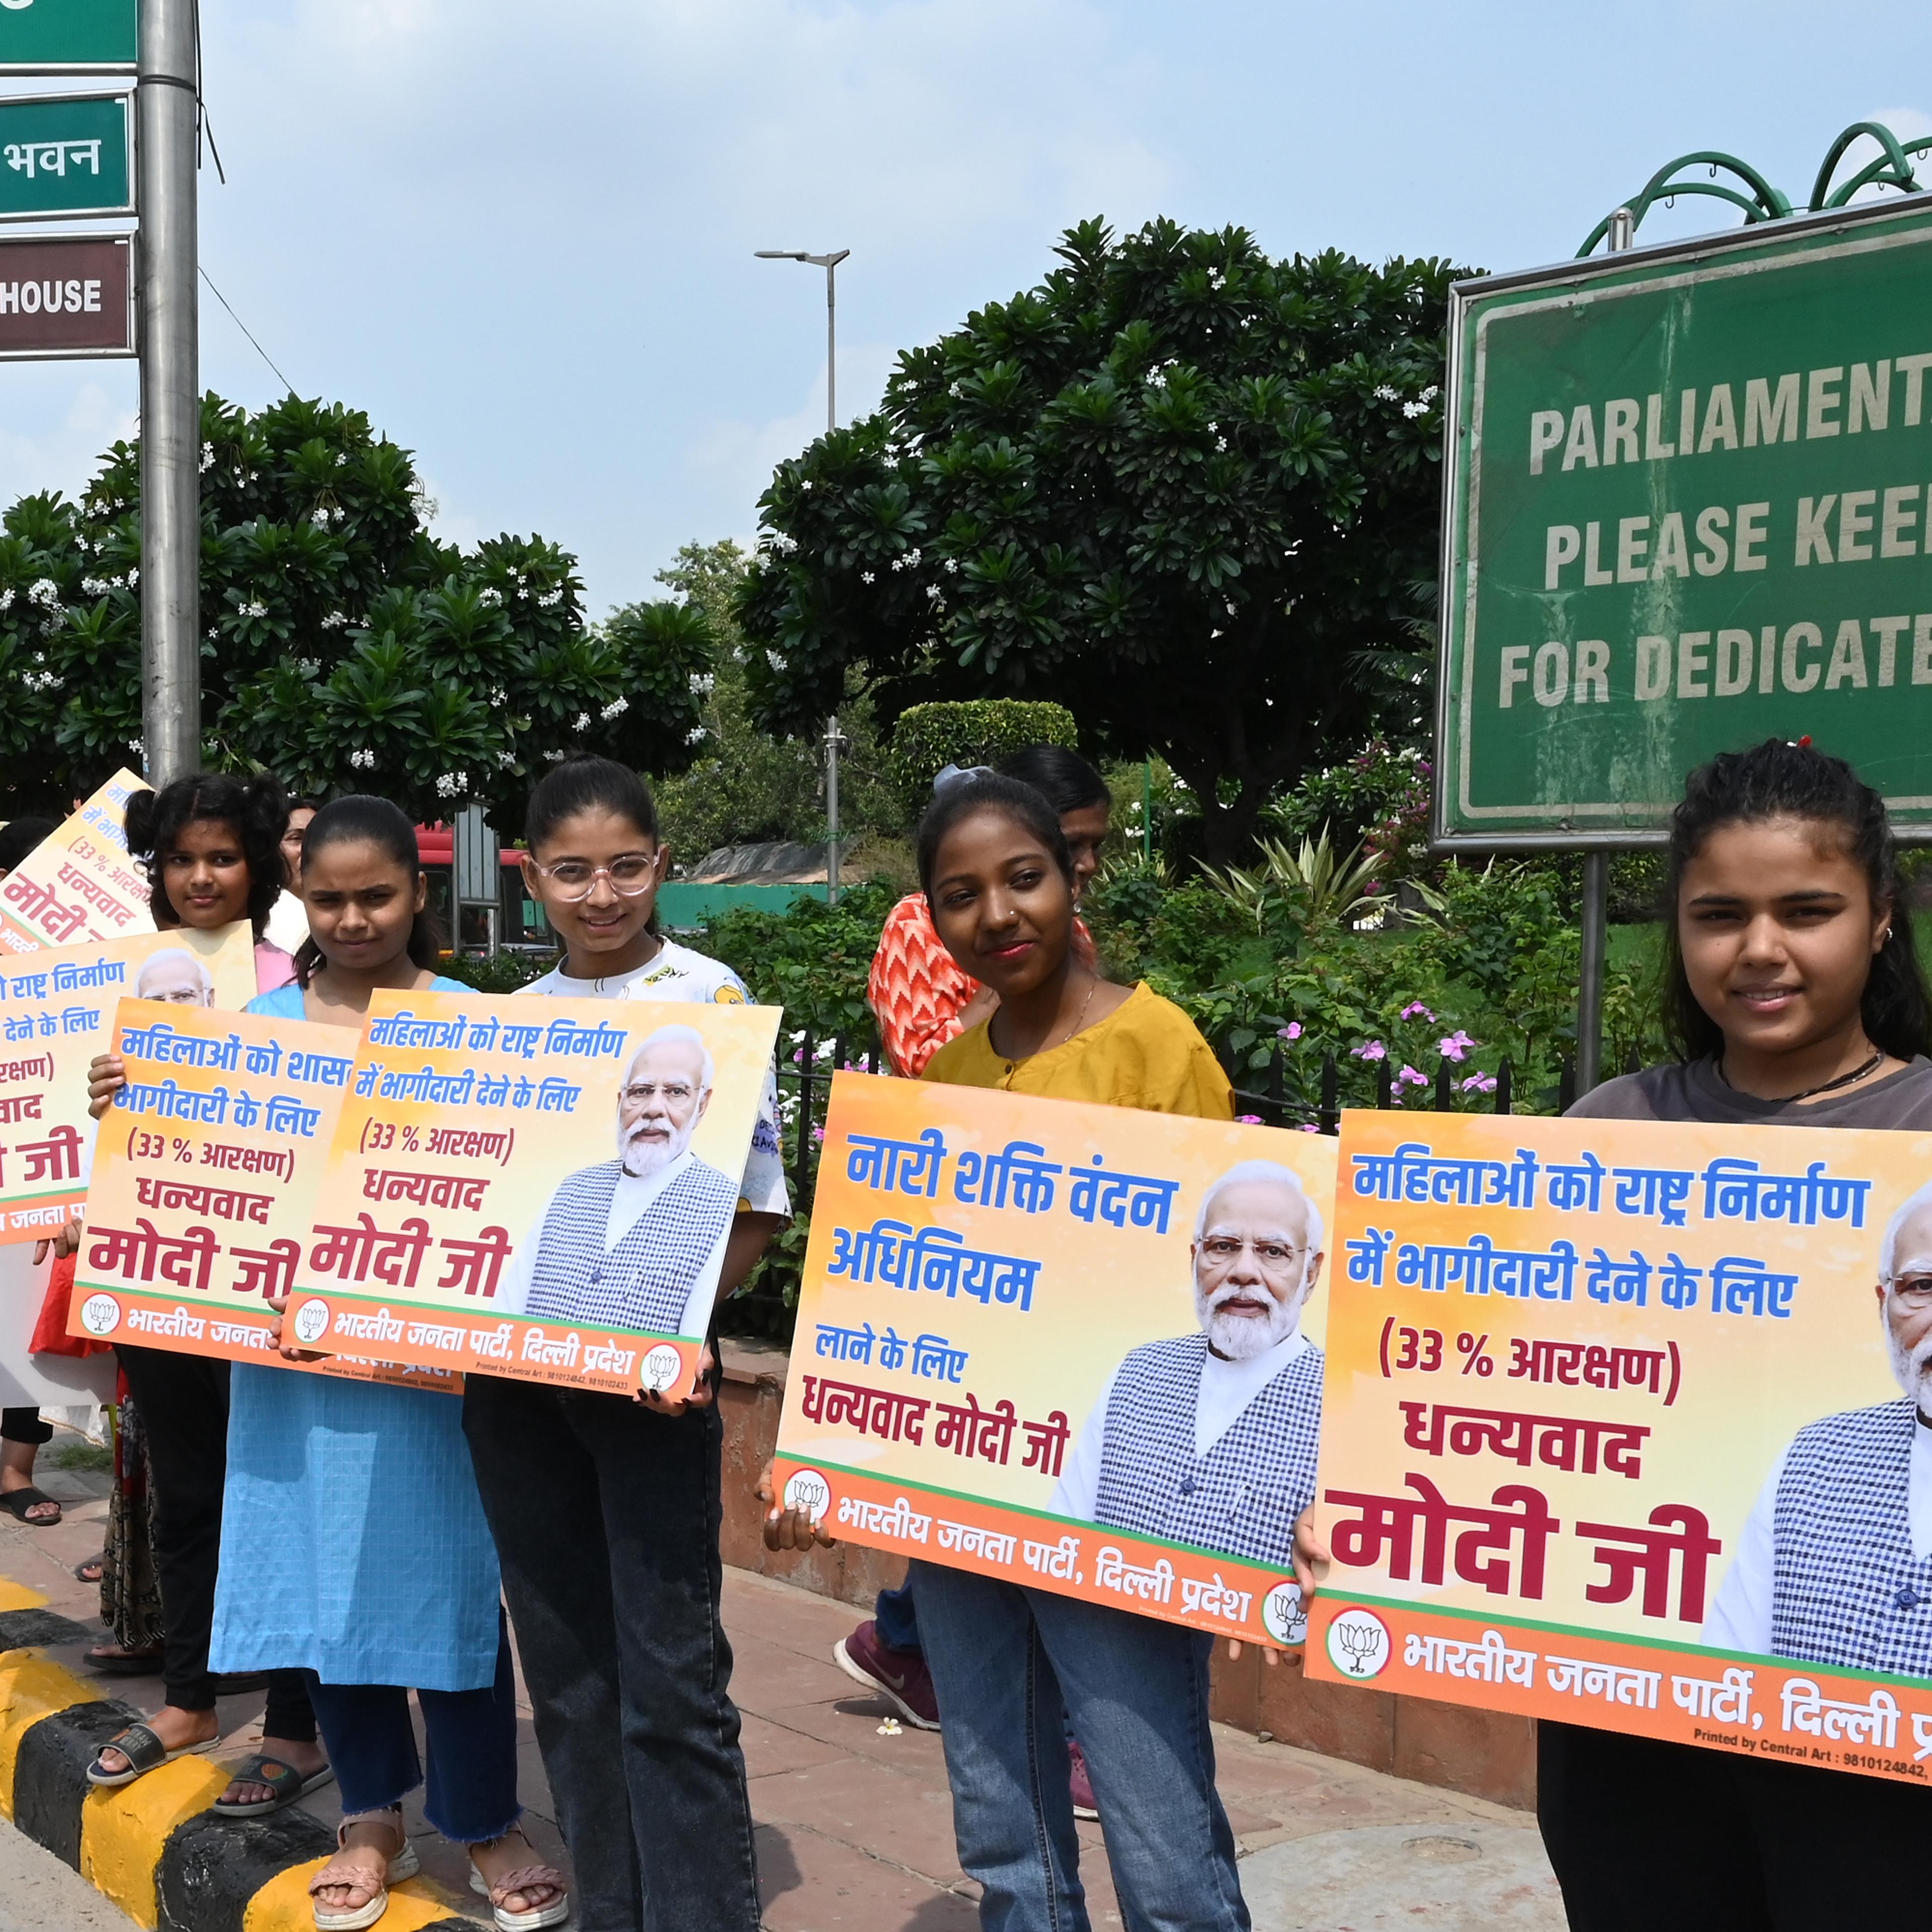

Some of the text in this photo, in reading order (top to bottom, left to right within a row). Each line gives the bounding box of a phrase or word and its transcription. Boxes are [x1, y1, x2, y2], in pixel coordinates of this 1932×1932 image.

[4, 139, 101, 178] भवन
[0, 280, 101, 314] HOUSE
[1530, 352, 1932, 475] PARLIAMENT
[1545, 484, 1932, 590] PLEASE KEE
[1499, 639, 1611, 708] FOR
[68, 836, 96, 859] (33
[94, 855, 110, 871] %
[4, 872, 87, 942] मोदी
[57, 862, 136, 927] धन्यवाद
[11, 973, 48, 999] राष्ट्र
[52, 957, 125, 992] निर्माण
[4, 1007, 100, 1041] देने के लिए
[122, 1023, 354, 1087] महिलाओं को शास
[369, 1012, 627, 1059] महिलाओं को राष्ट्र निर्माण
[114, 1080, 321, 1137] भागीदारी के लिए
[355, 1064, 582, 1112] में भागीदारी देने के लिए
[15, 1125, 84, 1181] जी
[127, 1127, 295, 1183] (33 % आरक्षण)
[360, 1117, 514, 1166] (33 % आरक्षण)
[136, 1177, 275, 1225] धन्यवाद
[363, 1169, 491, 1211] धन्यवाद
[847, 1129, 1180, 1234] नारी शक्ति वंदन
[1353, 1144, 1871, 1228] महिलाओं को राष्ट्र निर्माण
[9, 1204, 65, 1228] जनता
[87, 1218, 301, 1299] मोदी जी
[309, 1212, 513, 1298] मोदी जी
[828, 1220, 1041, 1311] अधिनियम
[1347, 1228, 1799, 1318] में भागीदारी देने के लिए
[127, 1306, 206, 1340] भारतीय
[334, 1308, 636, 1375] भारतीय जनता पार्टी, दिल्ली प्रदेश
[816, 1323, 969, 1383] लाने के लिए
[476, 1361, 498, 1372] Printed
[499, 1365, 507, 1374] by
[508, 1366, 531, 1377] Central
[1380, 1317, 1681, 1406] (33 % आरक्षण)
[802, 1375, 1071, 1477] धन्यवाद मोदी जी
[1399, 1401, 1651, 1479] धन्यवाद
[837, 1497, 1253, 1623] भारतीय जनता पार्टी, दिल्ली प्रदेश
[1325, 1472, 1722, 1624] मोदी जी
[1404, 1631, 1537, 1687] भारतीय
[1546, 1656, 1661, 1708] जनता
[1671, 1668, 1763, 1730] पार्टी,
[1780, 1678, 1901, 1748] दिल्ली
[1695, 1728, 1737, 1746] Printed
[1742, 1738, 1757, 1752] by
[1760, 1739, 1807, 1758] Central
[1812, 1748, 1831, 1762] Art
[1843, 1753, 1928, 1781] 9810124842,
